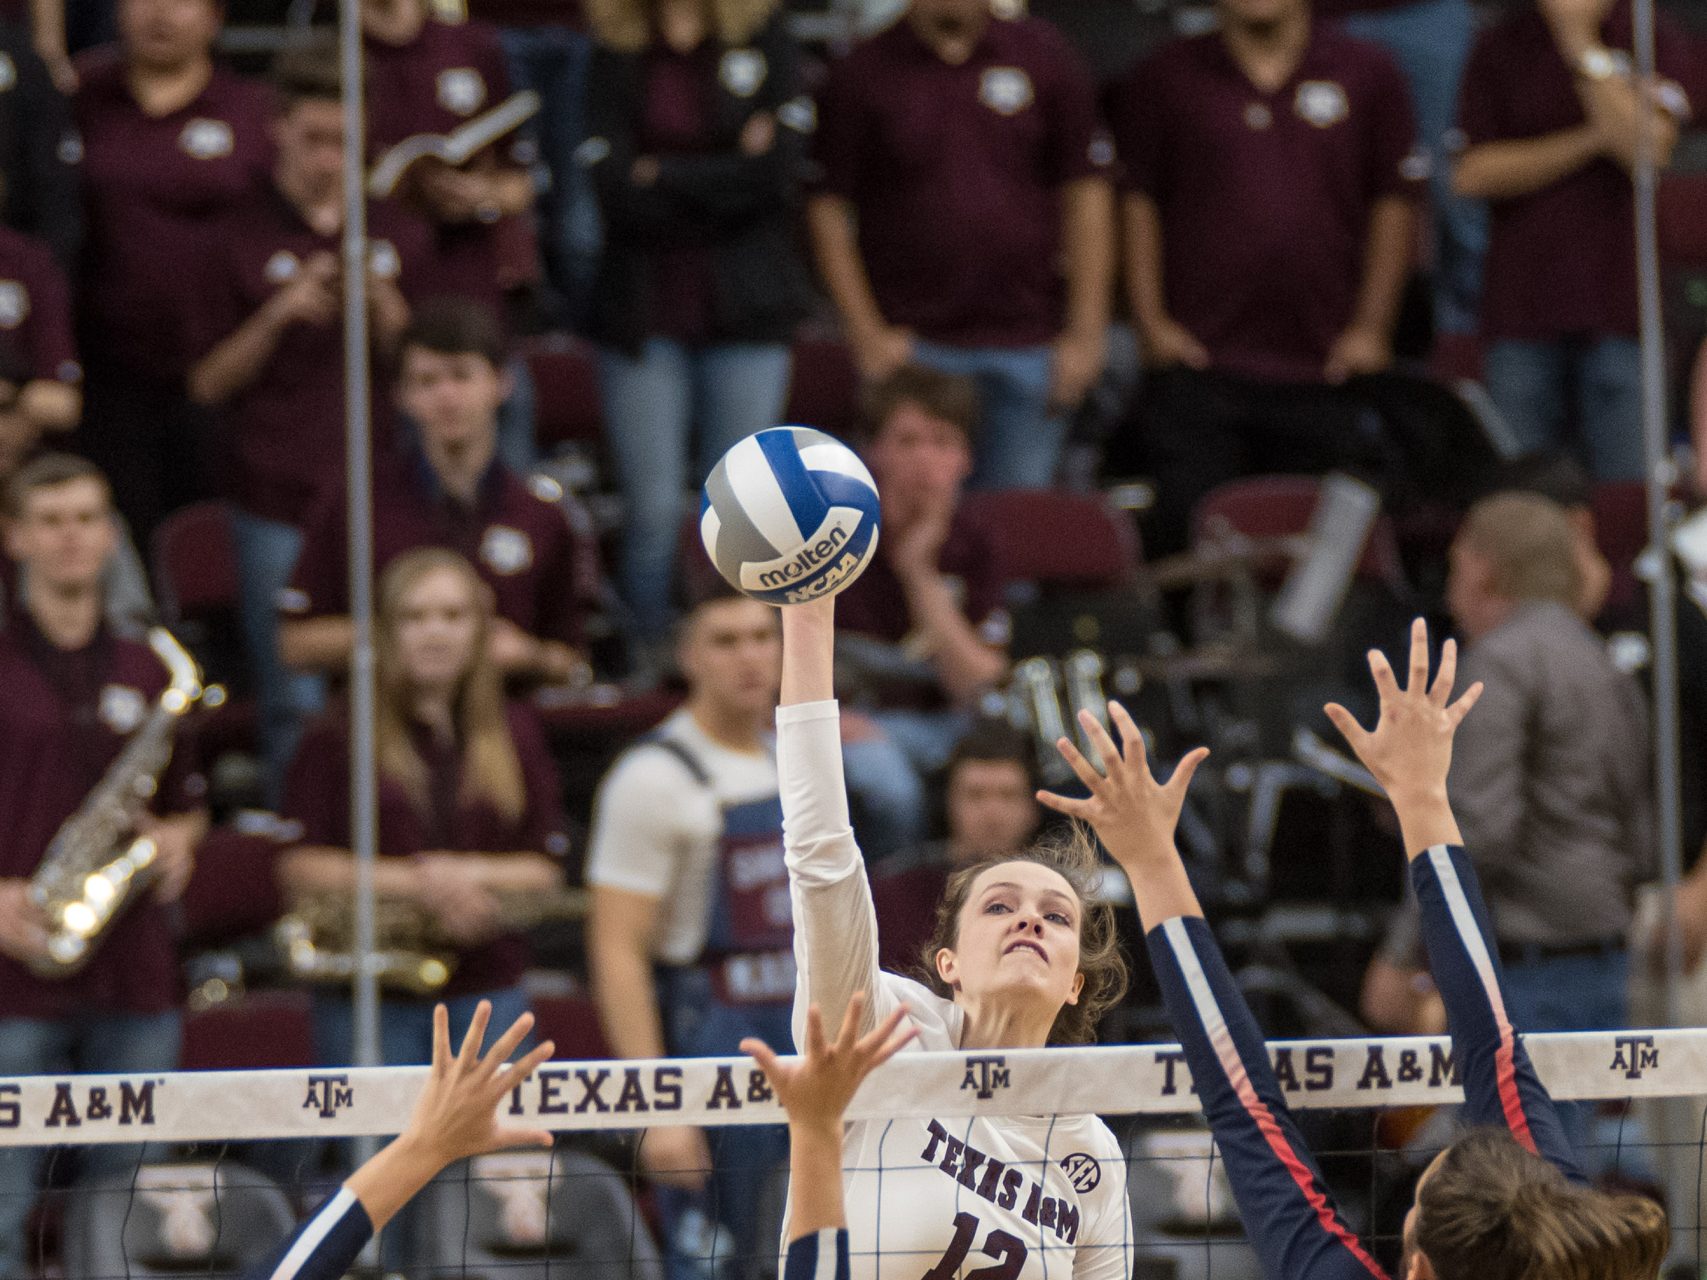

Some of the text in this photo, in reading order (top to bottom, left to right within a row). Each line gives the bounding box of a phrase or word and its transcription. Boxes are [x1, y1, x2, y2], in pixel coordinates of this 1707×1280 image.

[759, 526, 848, 588] molten
[785, 552, 858, 603] NCAA
[507, 1065, 784, 1115] TEXAS A&
[1154, 1046, 1336, 1096] TAS
[44, 1079, 156, 1128] A&M
[920, 1118, 1081, 1246] TEXAS A&M
[1060, 1153, 1101, 1194] SEC
